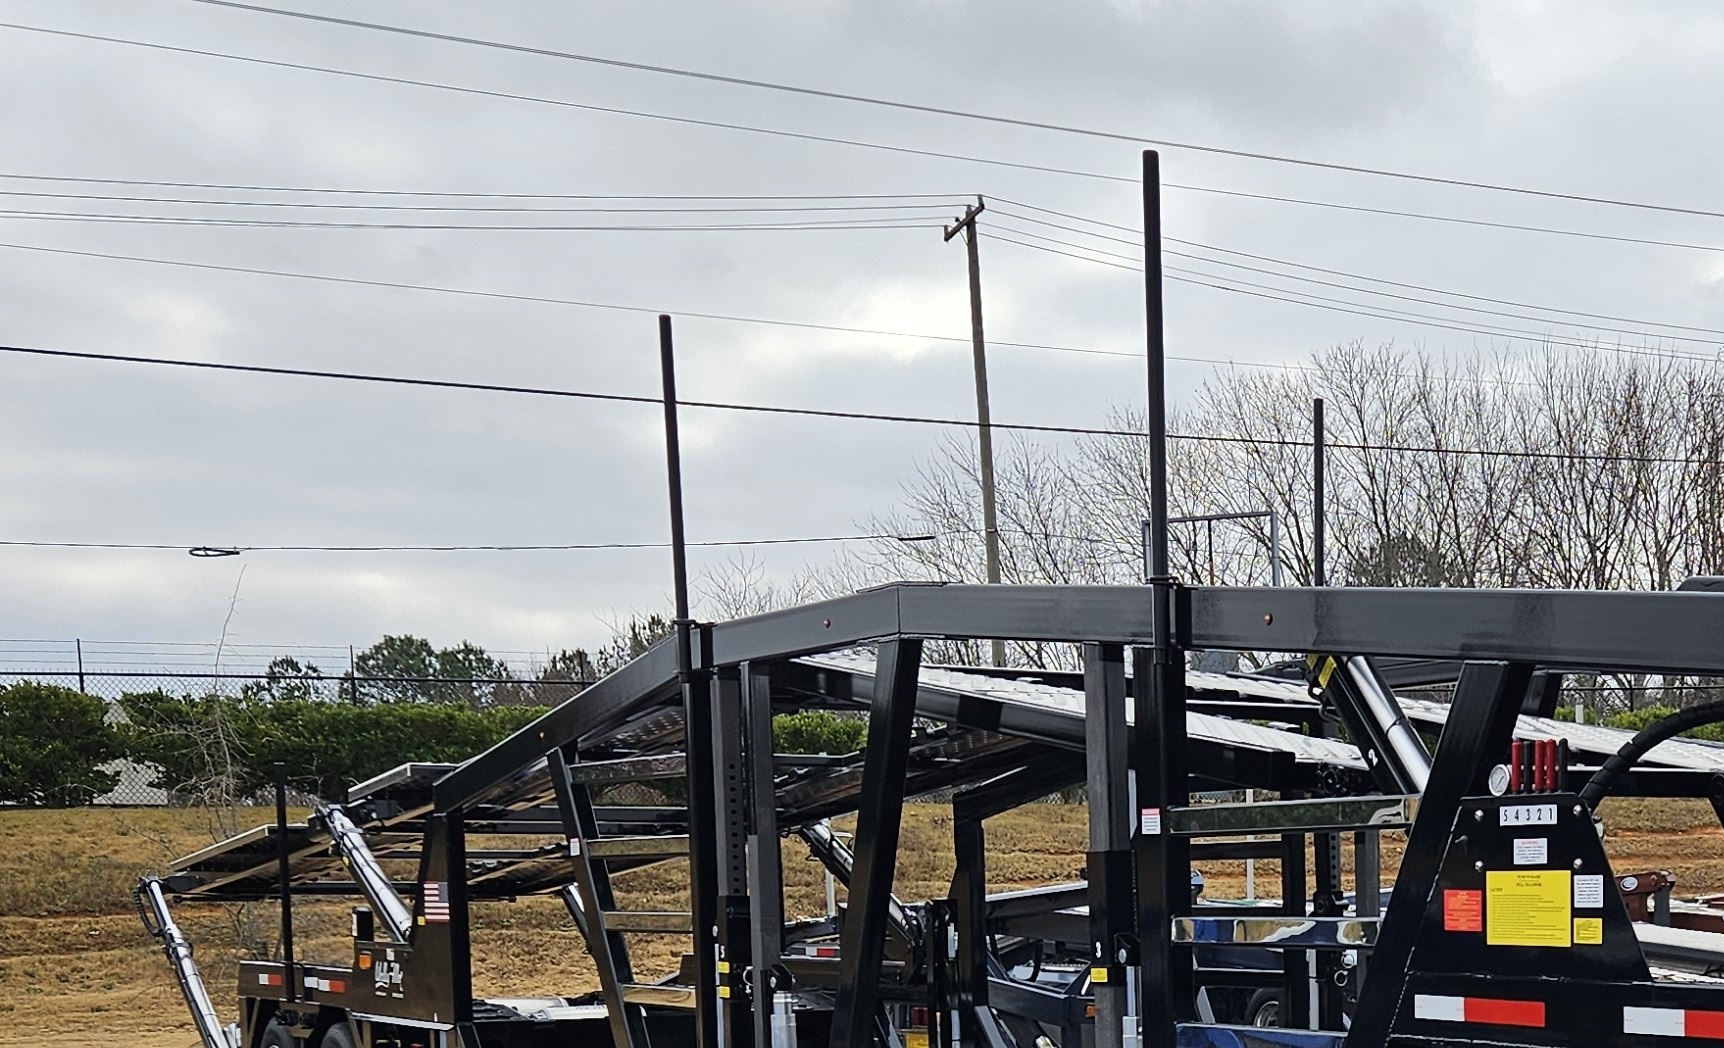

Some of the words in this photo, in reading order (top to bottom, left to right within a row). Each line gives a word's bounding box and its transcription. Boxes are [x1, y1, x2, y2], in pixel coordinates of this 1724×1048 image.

[1503, 809, 1509, 822] 5
[1514, 809, 1520, 822] 4
[1525, 808, 1531, 821] 3
[1536, 807, 1542, 821] 2
[1548, 807, 1553, 820] 1
